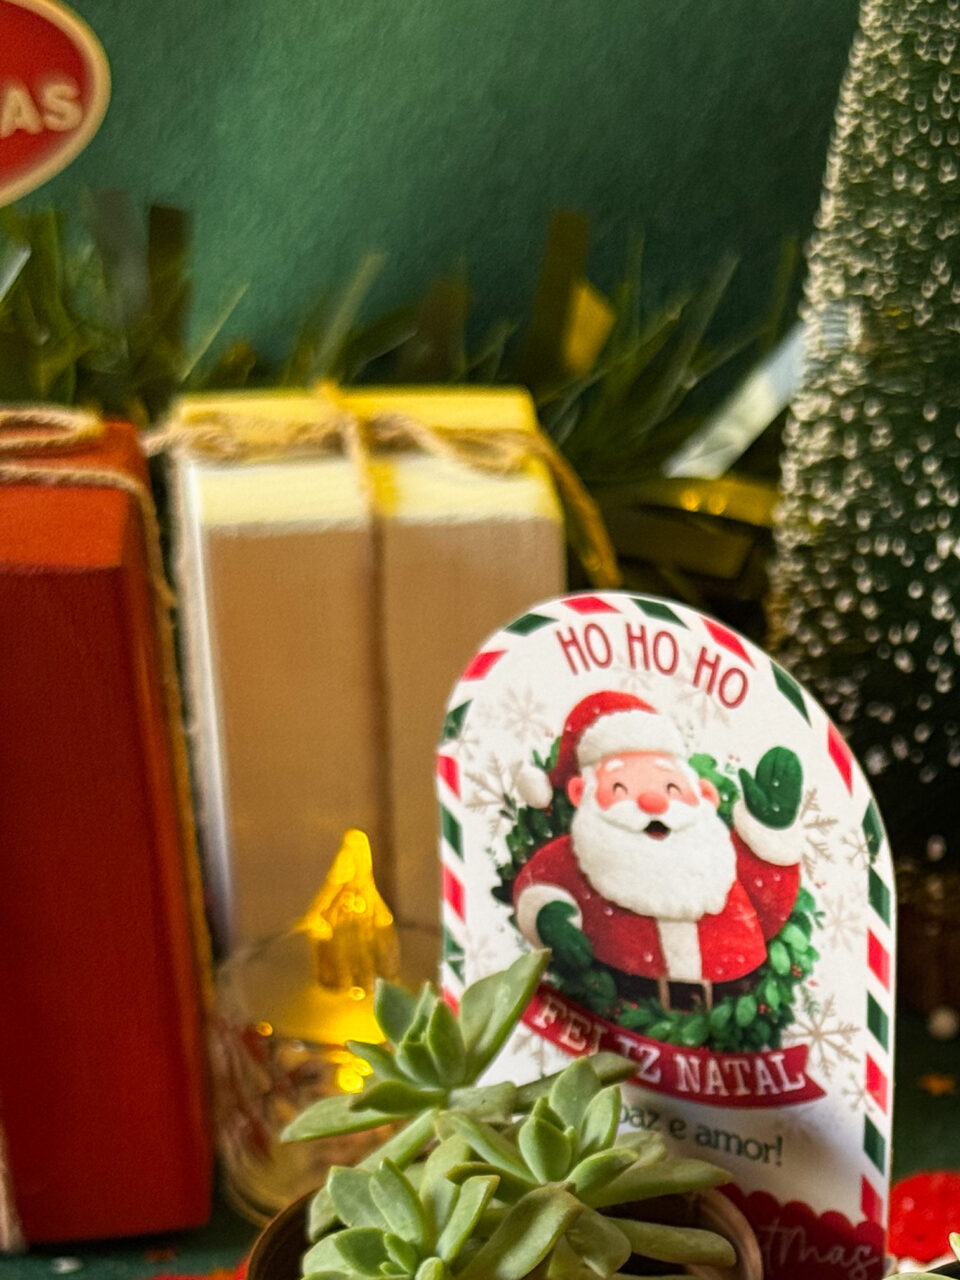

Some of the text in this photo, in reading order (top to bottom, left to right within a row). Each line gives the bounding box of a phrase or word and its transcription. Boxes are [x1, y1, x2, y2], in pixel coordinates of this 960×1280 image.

[555, 622, 749, 709] HO HO HO
[674, 1052, 807, 1097] NATAL
[669, 1118, 687, 1140] e
[695, 1123, 783, 1168] amor!
